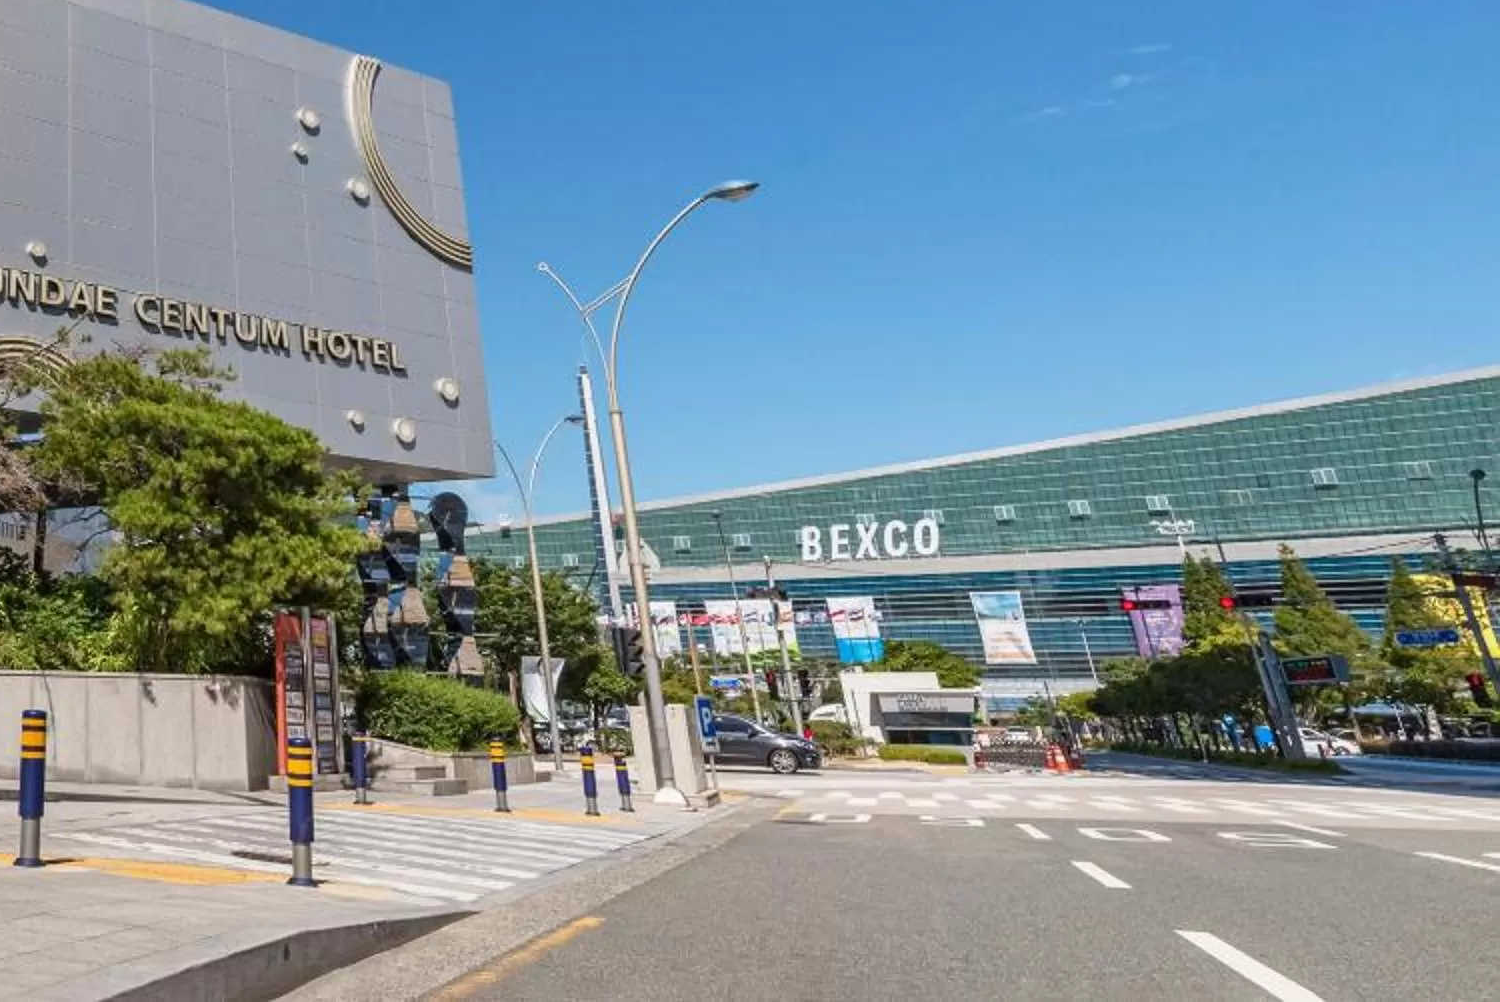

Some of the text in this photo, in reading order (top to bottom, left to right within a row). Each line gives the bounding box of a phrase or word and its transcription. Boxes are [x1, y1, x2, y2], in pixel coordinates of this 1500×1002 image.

[134, 294, 289, 349] CENTUM
[301, 325, 406, 372] HOTEL
[801, 517, 939, 561] BEXCO
[701, 706, 713, 734] P
